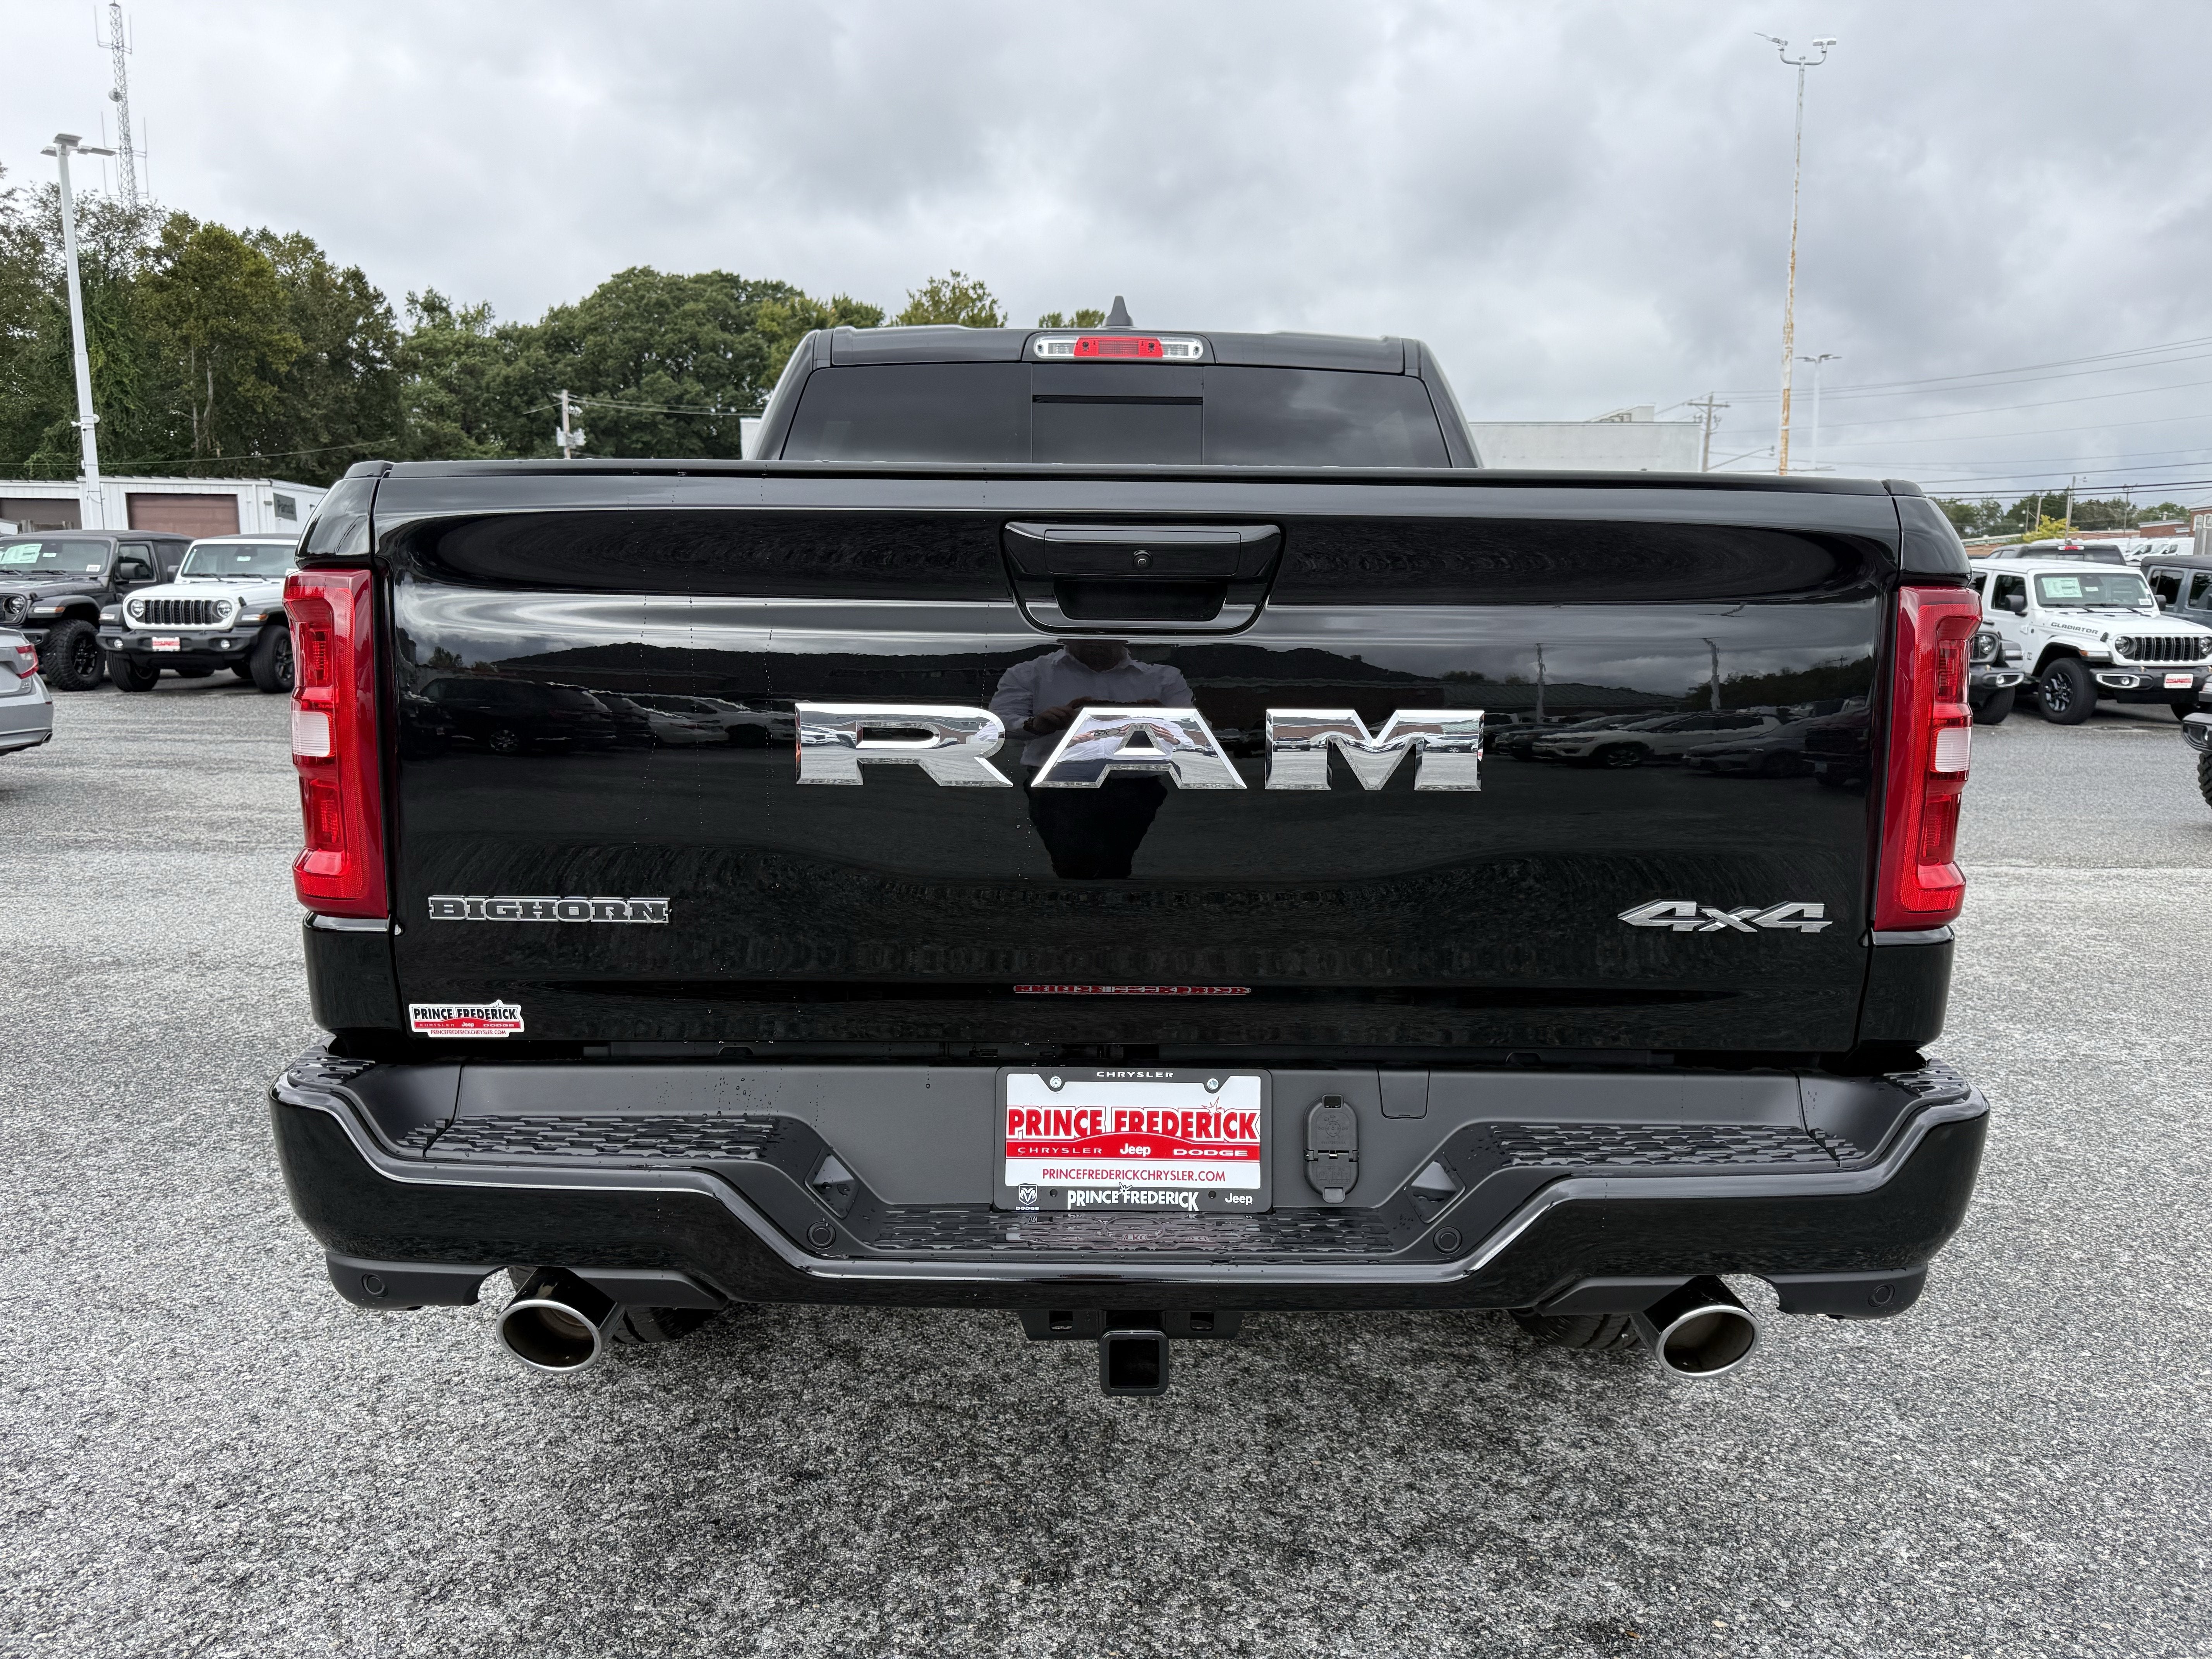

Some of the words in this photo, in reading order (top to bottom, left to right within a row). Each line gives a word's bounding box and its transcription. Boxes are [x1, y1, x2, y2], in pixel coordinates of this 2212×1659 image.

[2051, 622, 2098, 634] GLADIATOR
[795, 702, 1484, 792] RAM
[428, 895, 671, 923] BIGHORN
[1617, 898, 1834, 933] 4x4
[414, 1008, 453, 1020] PRINCE
[457, 1008, 517, 1020] FREDERICK
[1008, 1109, 1103, 1138] PRINCE
[1114, 1110, 1258, 1139] FREDERICK
[1120, 1143, 1151, 1157] Jeep
[1042, 1168, 1226, 1182] PRINCEFREDERICKCHRYSLER.COM
[1067, 1190, 1119, 1210] PRINCE
[1123, 1190, 1199, 1211] FREDERICK
[1224, 1193, 1253, 1206] Jeep
